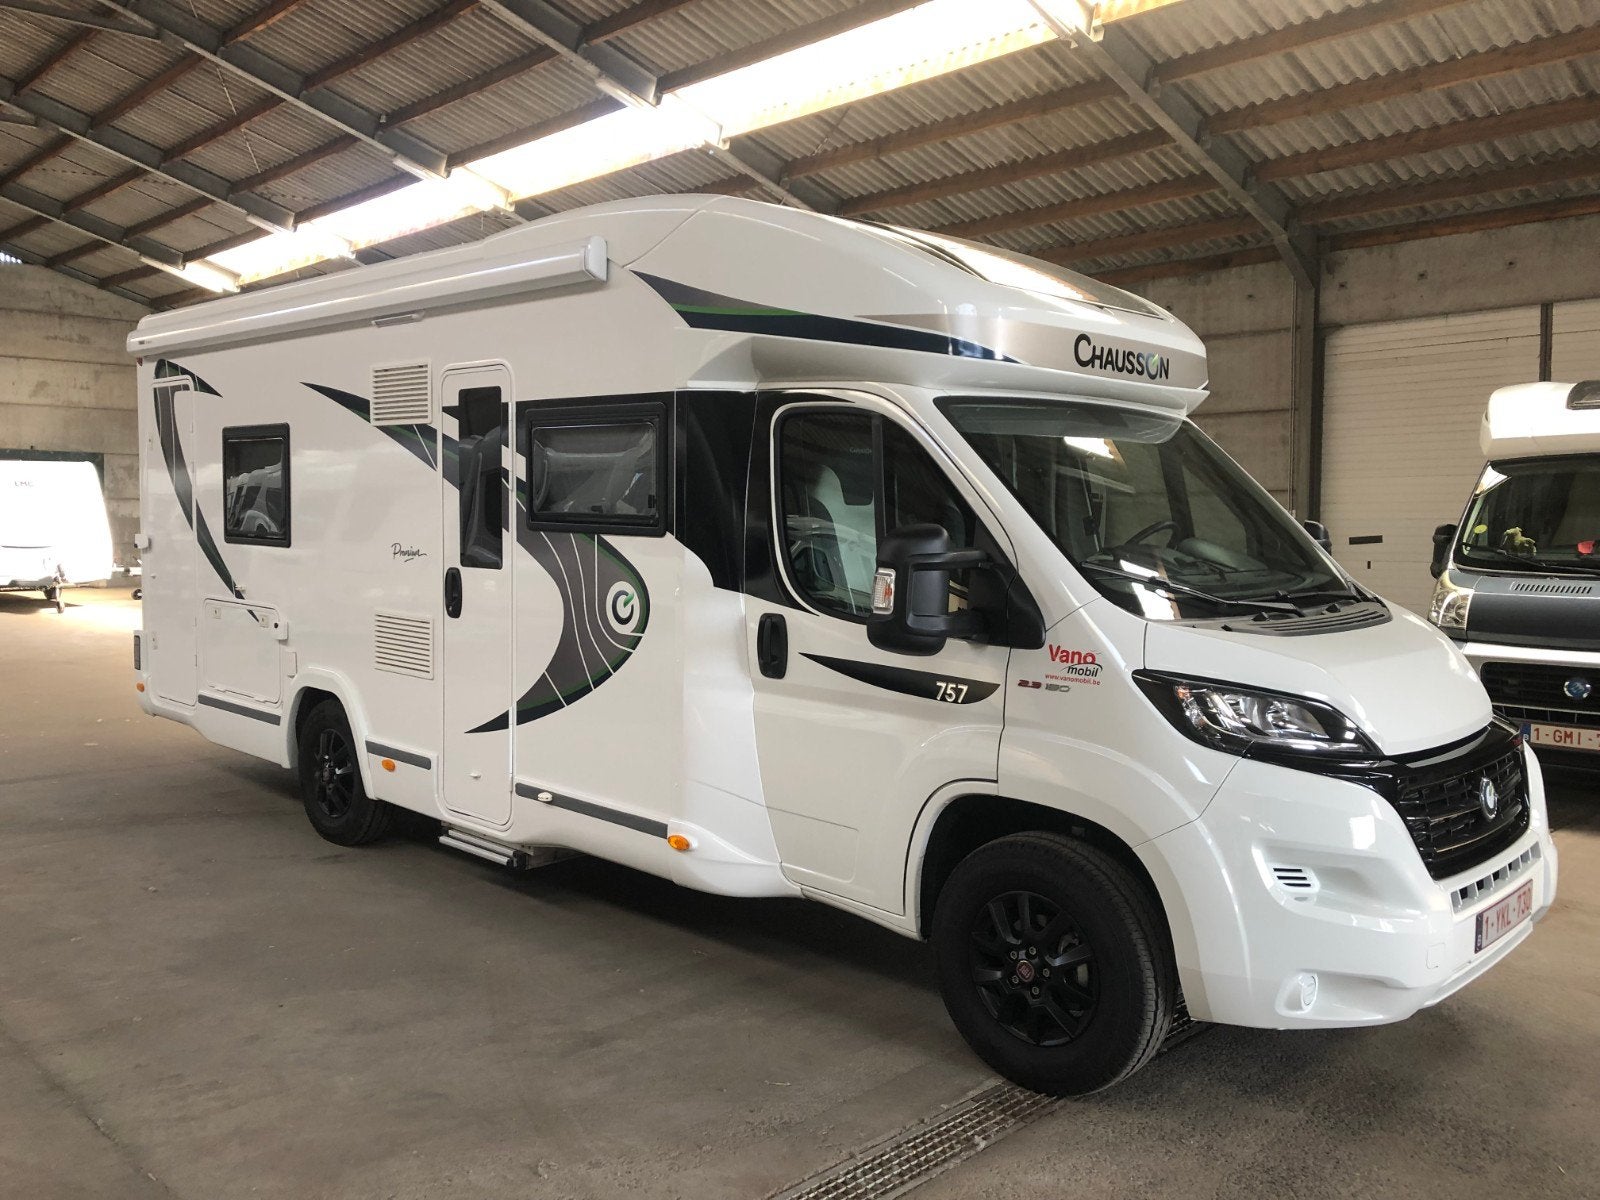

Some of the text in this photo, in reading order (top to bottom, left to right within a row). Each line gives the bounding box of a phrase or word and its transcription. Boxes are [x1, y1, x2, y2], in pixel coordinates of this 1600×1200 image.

[1048, 644, 1096, 664] Vano
[1067, 665, 1099, 677] mobil
[1018, 679, 1042, 689] 2.3
[1045, 674, 1101, 686] www.vanomobil.be
[936, 681, 968, 703] 757
[1485, 888, 1533, 940] 1-YKL-730
